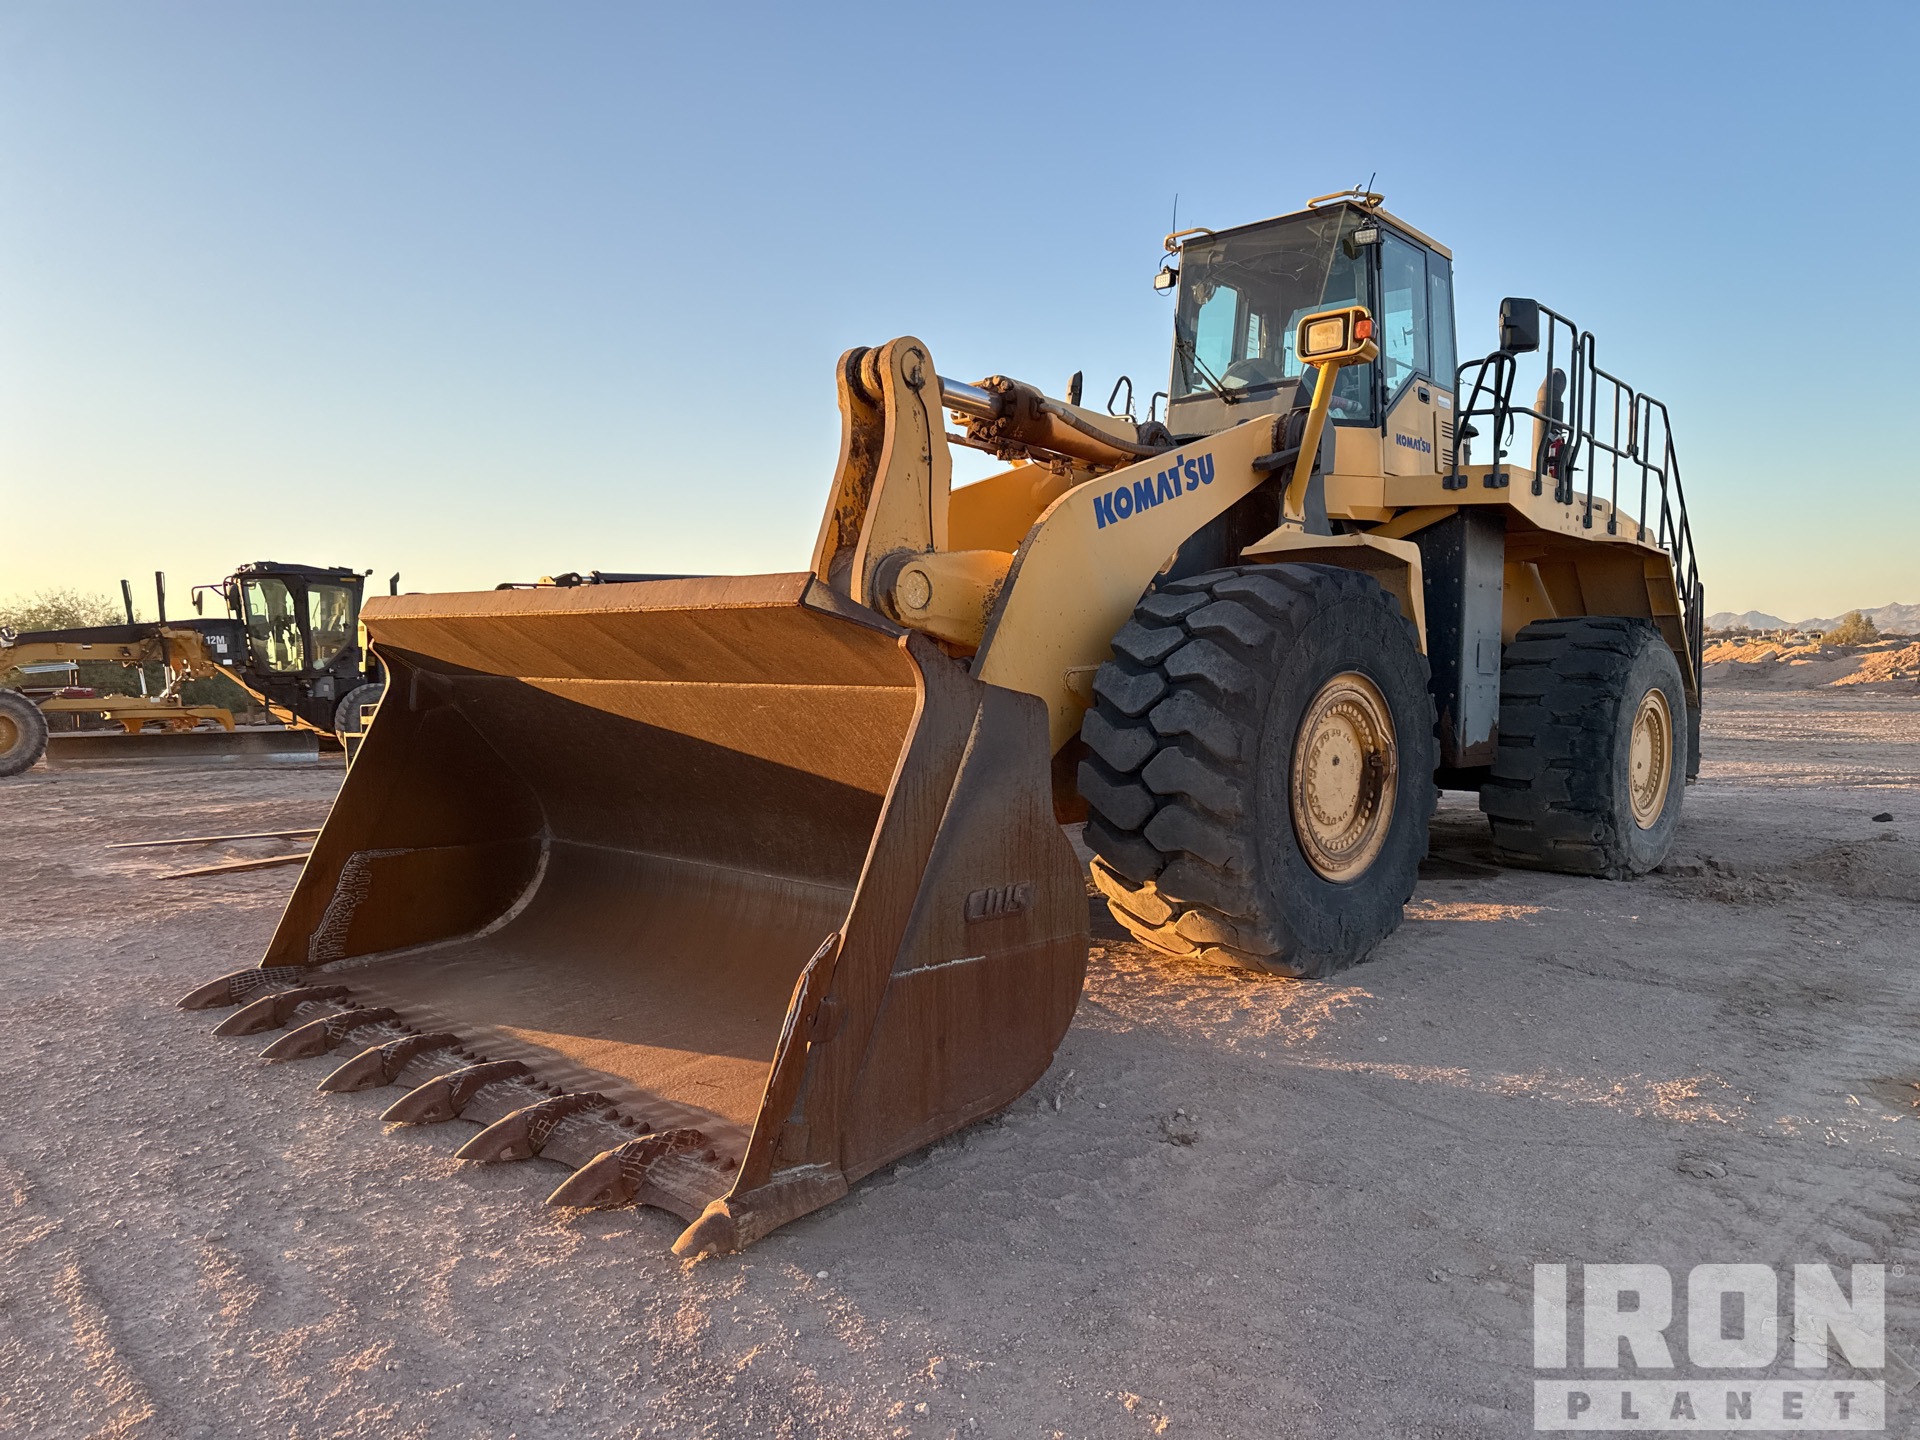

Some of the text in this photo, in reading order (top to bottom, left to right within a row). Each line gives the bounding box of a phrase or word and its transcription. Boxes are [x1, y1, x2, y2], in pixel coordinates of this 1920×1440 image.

[1396, 433, 1431, 454] KOMATSU
[1093, 453, 1215, 529] KOMATSU
[206, 635, 225, 645] 12M
